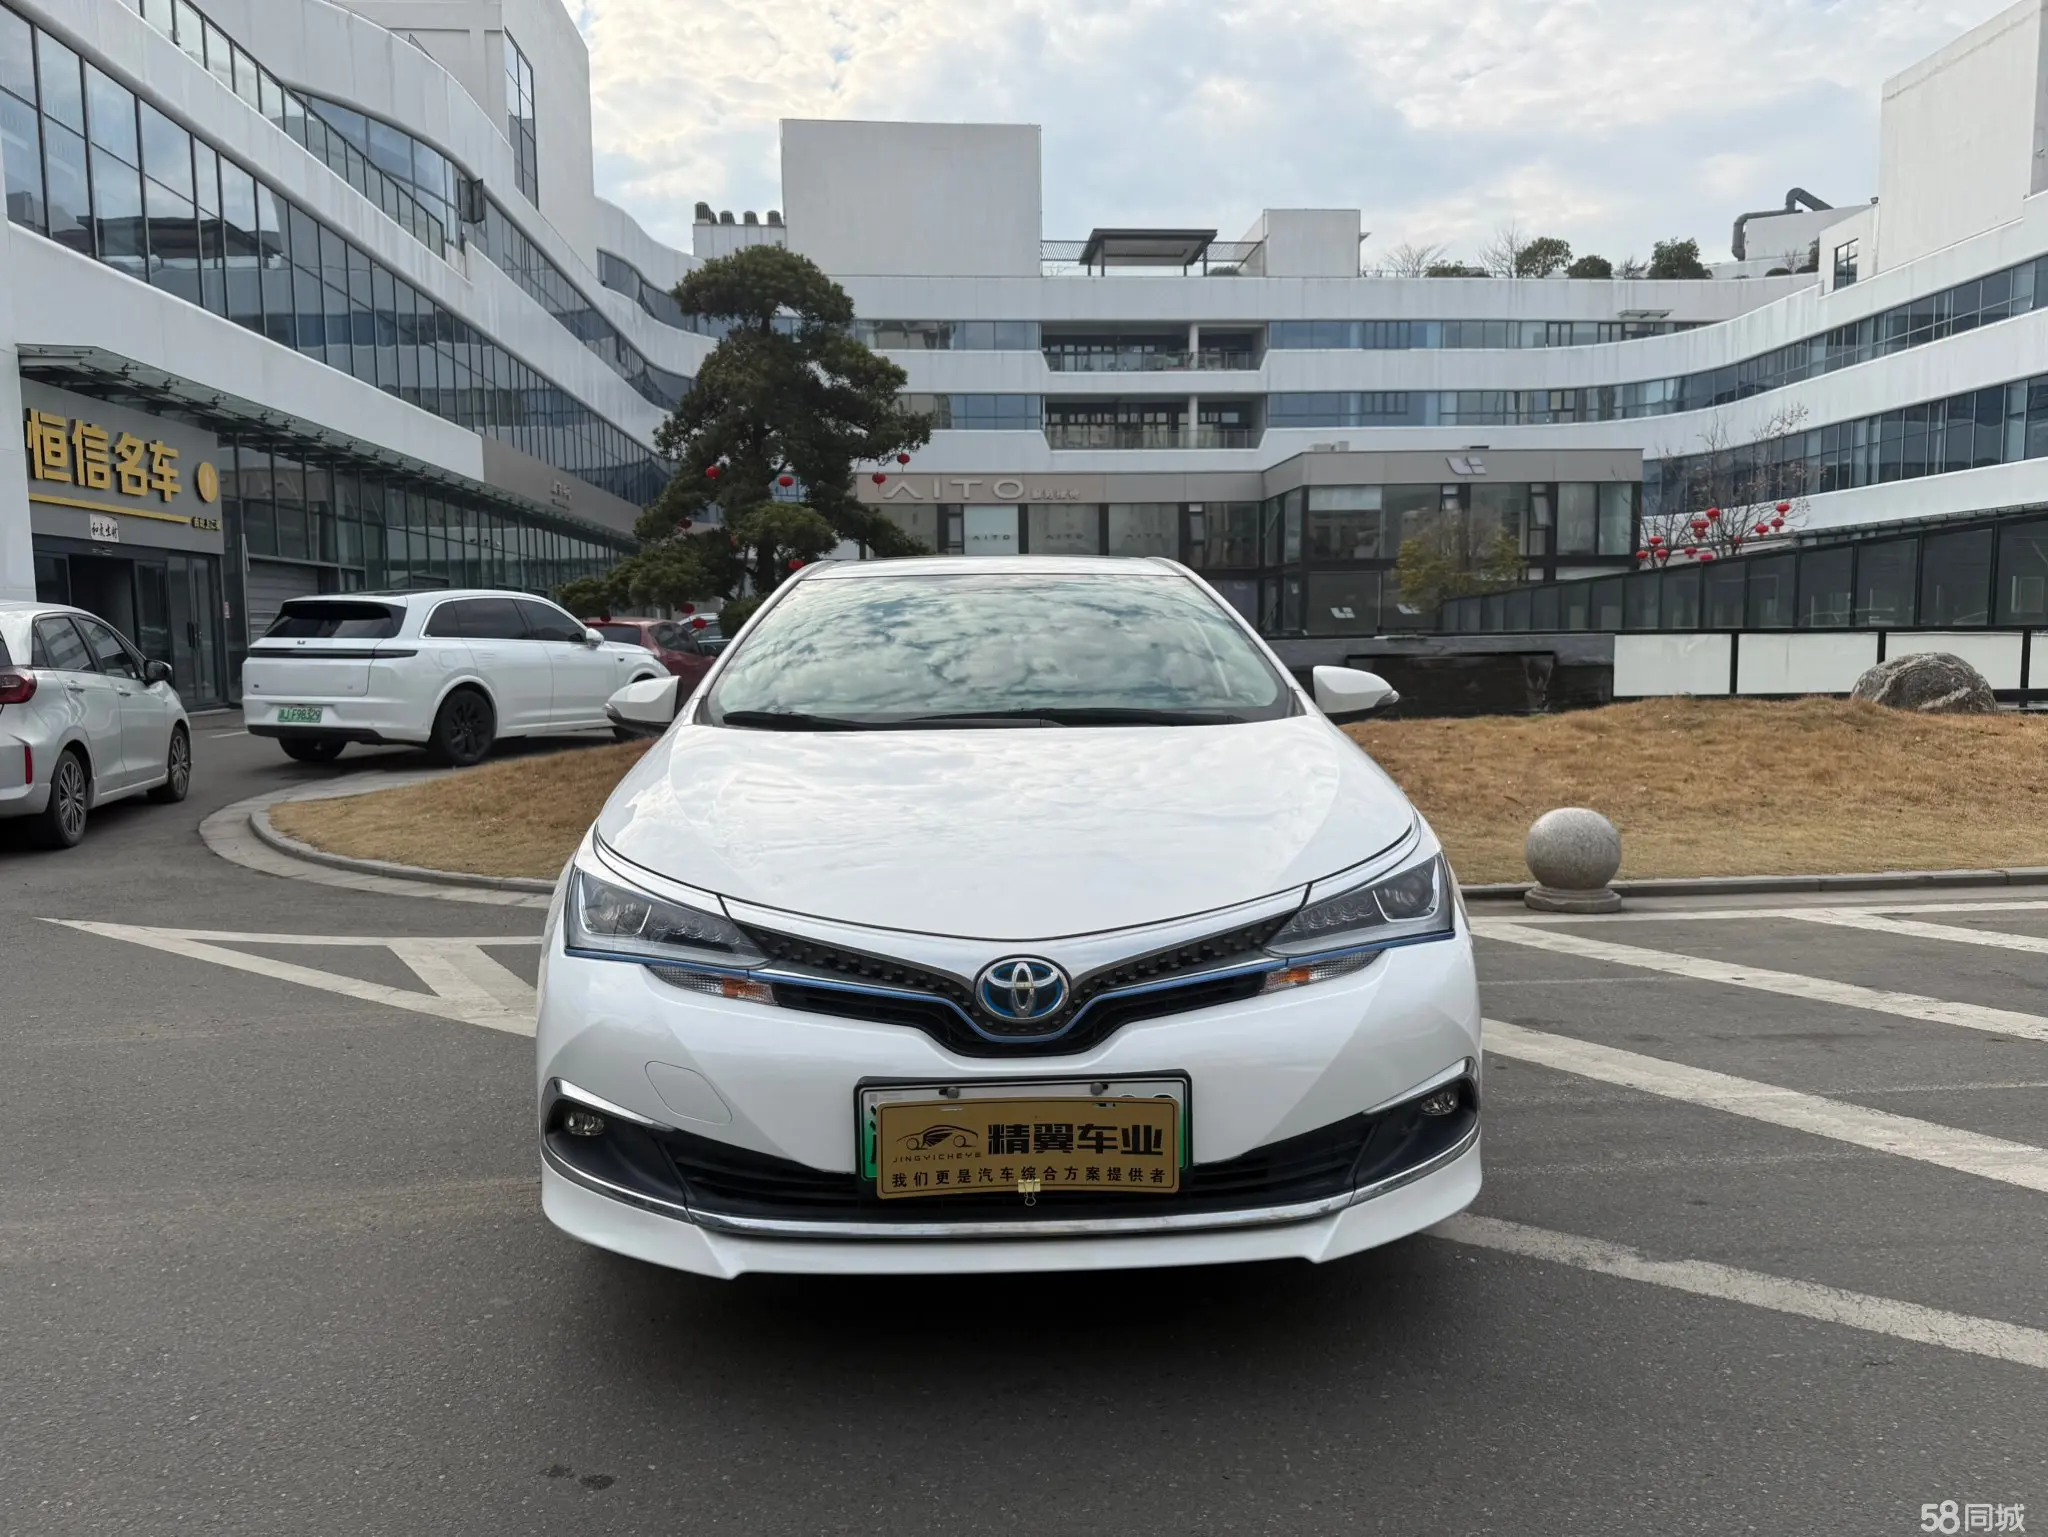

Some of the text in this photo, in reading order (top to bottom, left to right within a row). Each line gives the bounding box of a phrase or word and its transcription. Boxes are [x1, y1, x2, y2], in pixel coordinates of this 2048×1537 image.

[26, 407, 182, 502] 恒信名车
[883, 476, 1025, 500] AITO
[987, 1123, 1163, 1156] 精翼车业
[892, 1151, 982, 1163] JINGYICHEYE
[891, 1165, 1166, 1188] 我们更是汽车综合方案提供者
